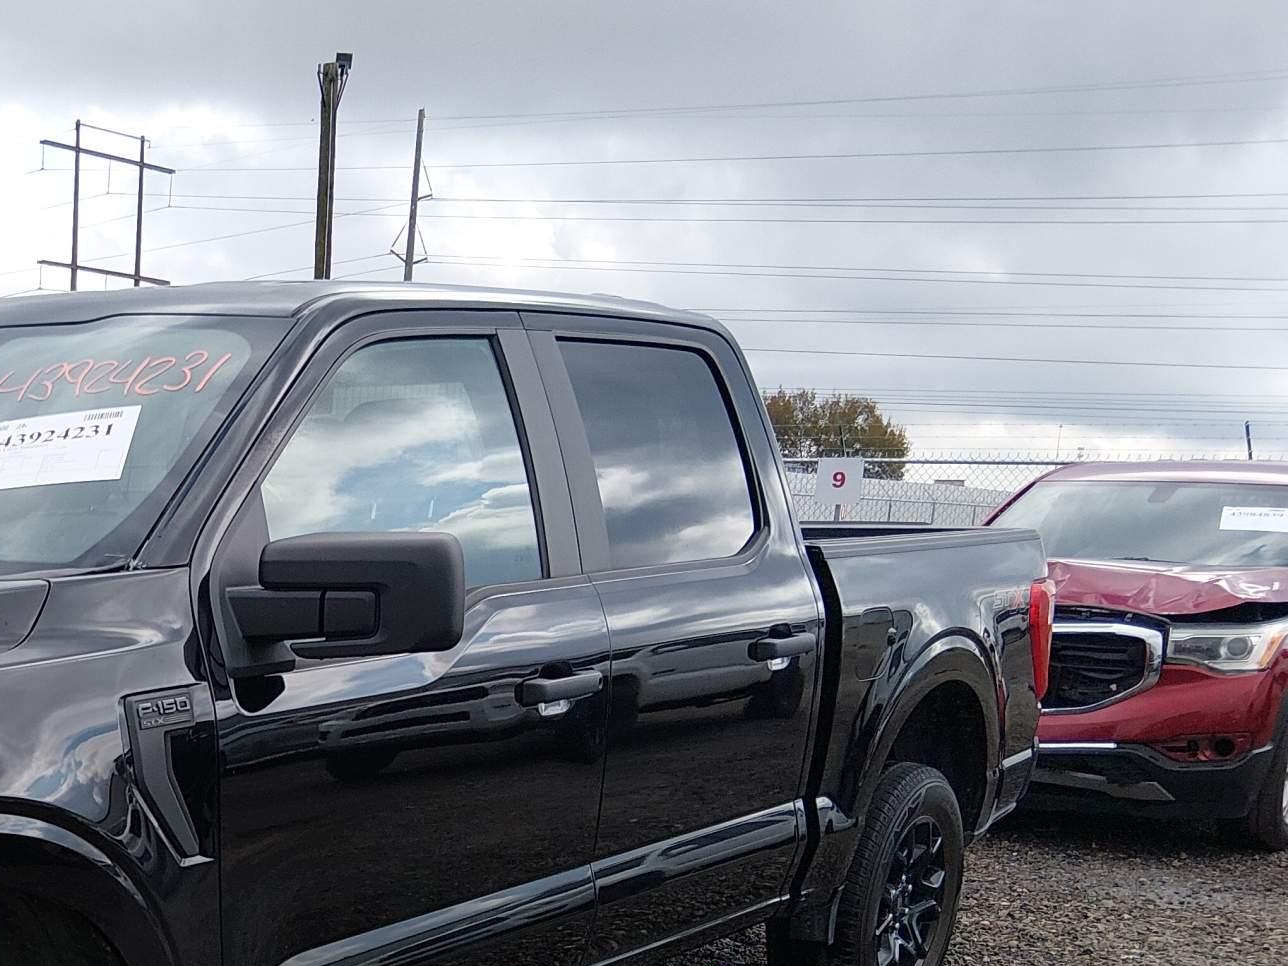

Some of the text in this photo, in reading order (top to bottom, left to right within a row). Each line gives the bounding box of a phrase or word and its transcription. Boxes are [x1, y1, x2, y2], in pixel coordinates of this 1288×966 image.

[0, 423, 113, 448] 43924231
[831, 472, 847, 489] 9
[138, 696, 191, 717] F-150
[142, 715, 165, 729] STX
